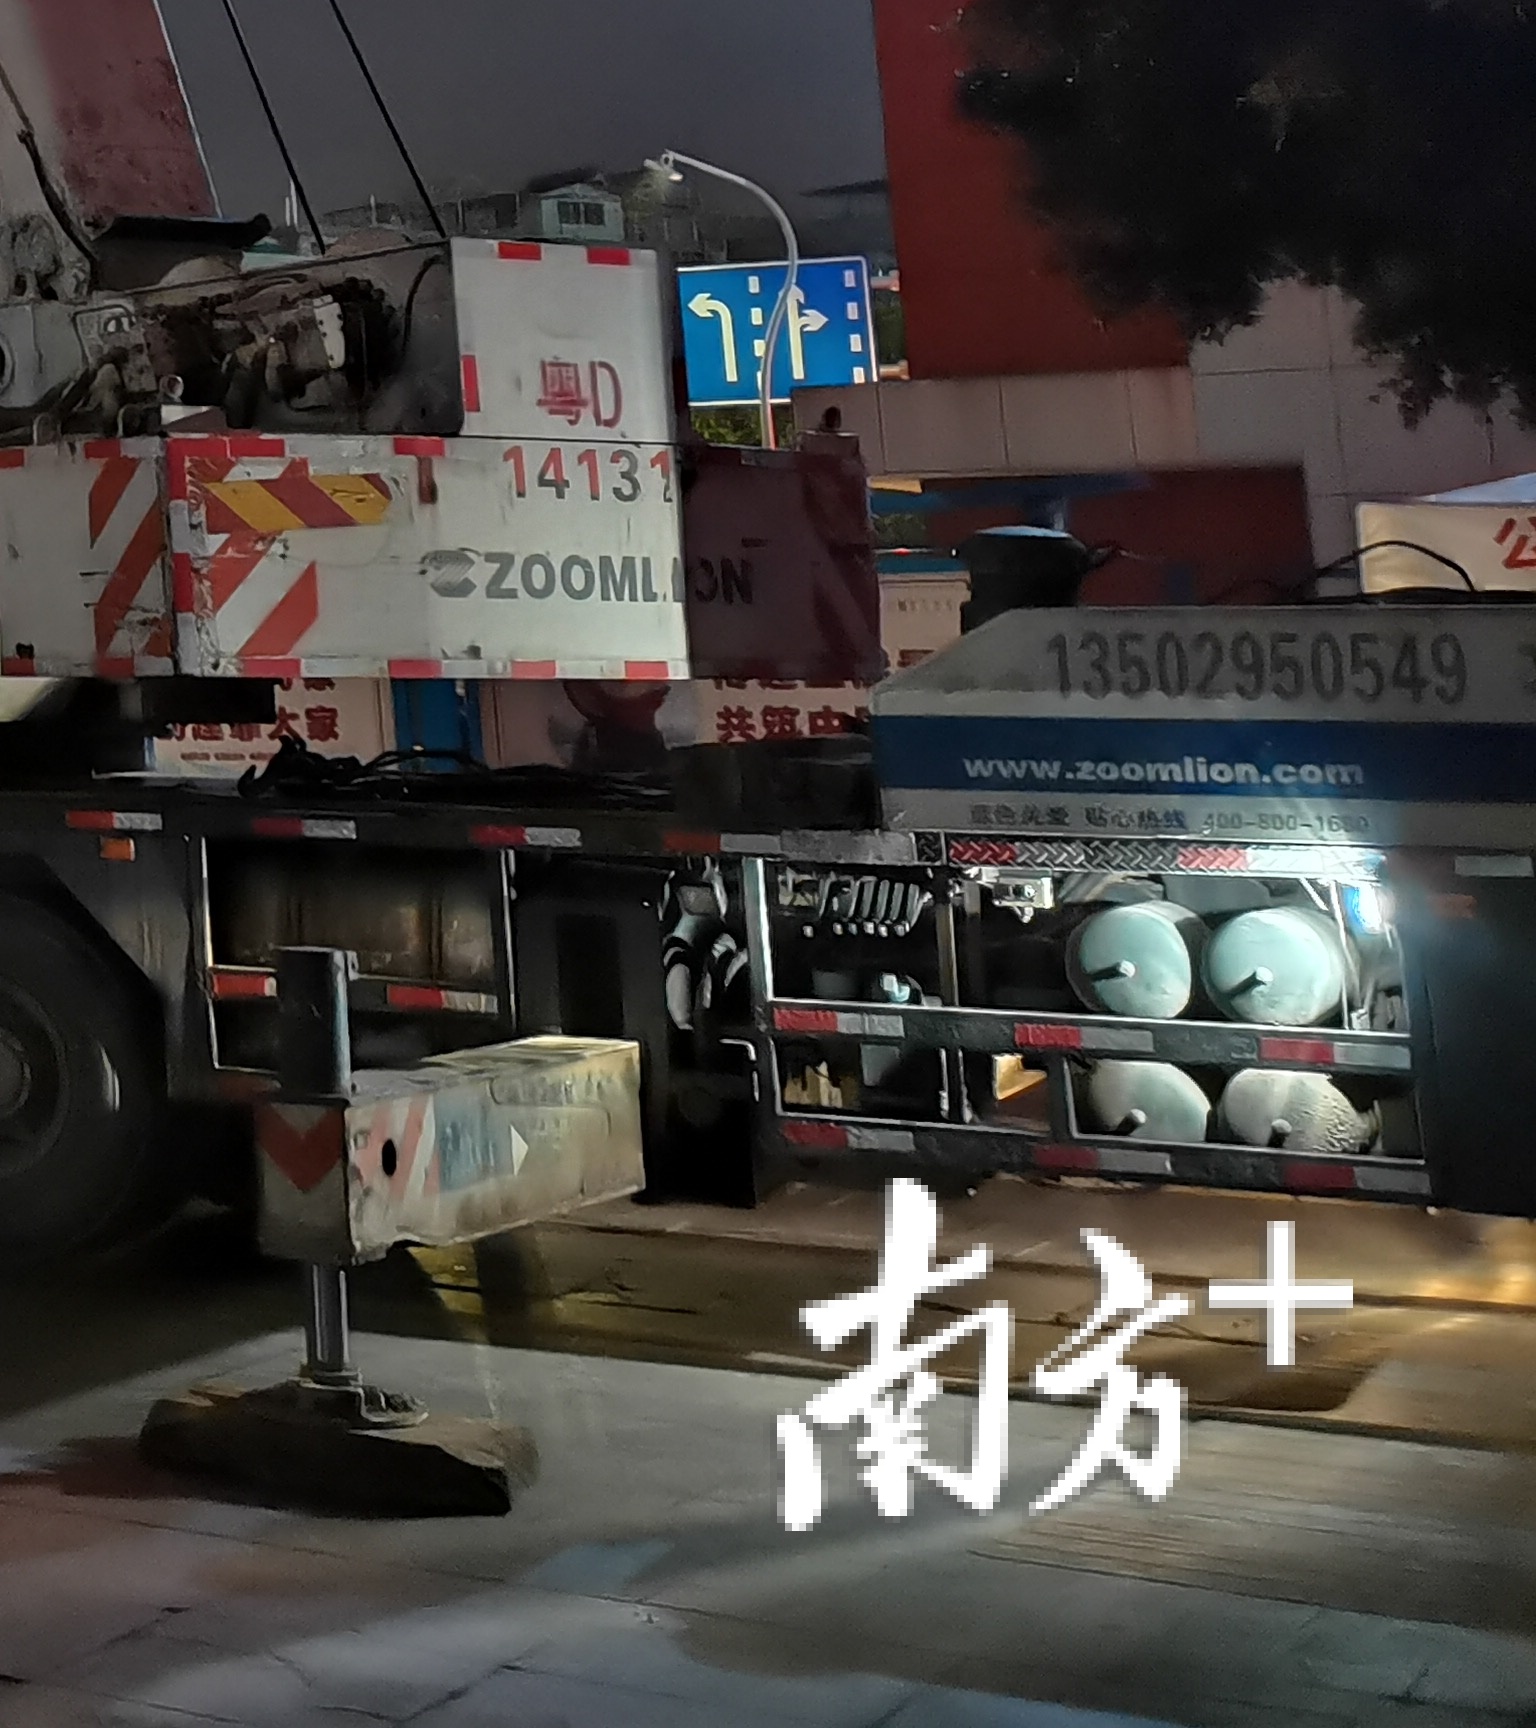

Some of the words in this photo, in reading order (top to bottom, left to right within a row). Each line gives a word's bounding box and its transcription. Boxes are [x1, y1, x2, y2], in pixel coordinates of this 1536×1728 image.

[536, 355, 623, 429] 粤D
[1047, 630, 1468, 704] 13502950549
[716, 705, 870, 743] 共筑中
[963, 755, 1365, 786] www.zoomlion.com
